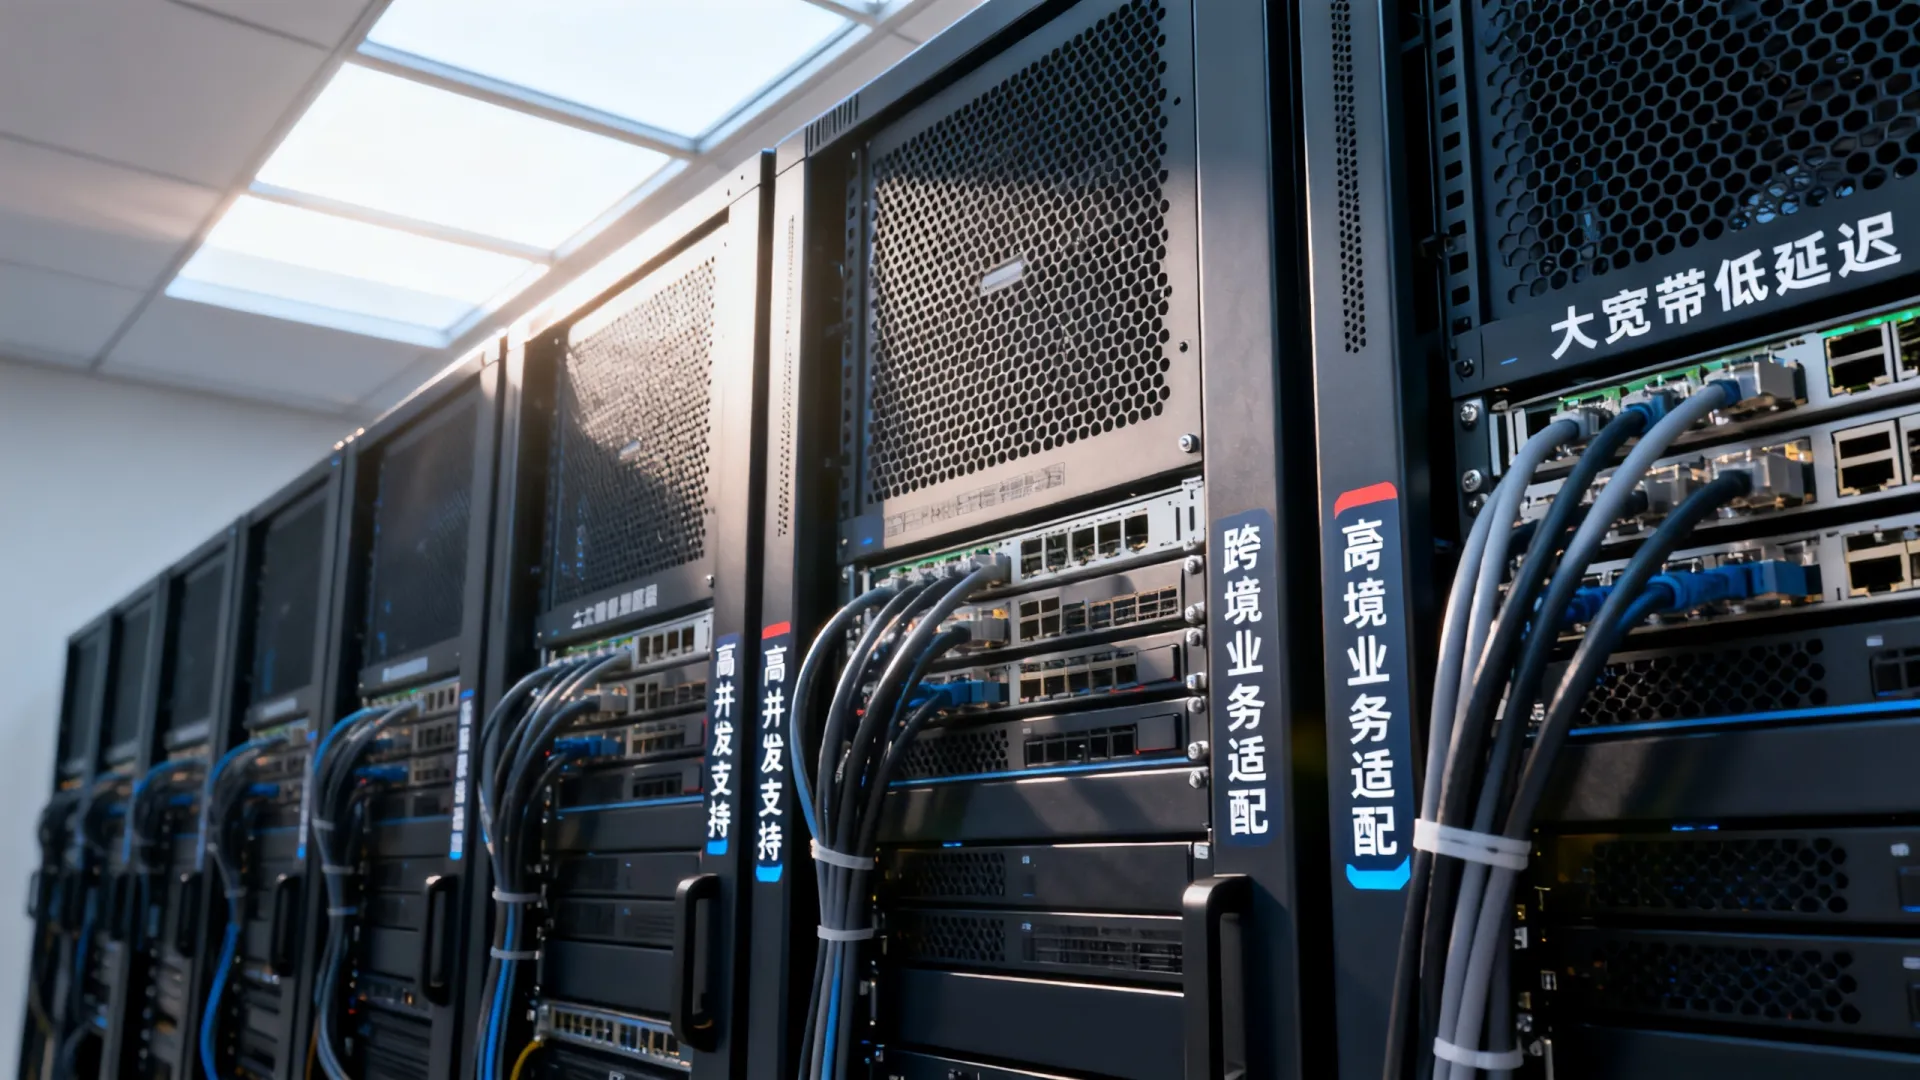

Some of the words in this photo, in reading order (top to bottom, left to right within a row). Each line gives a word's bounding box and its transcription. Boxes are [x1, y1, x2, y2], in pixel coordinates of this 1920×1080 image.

[1551, 211, 1902, 360] 大宽带低延迟
[1223, 524, 1269, 836] 跨境业务适配
